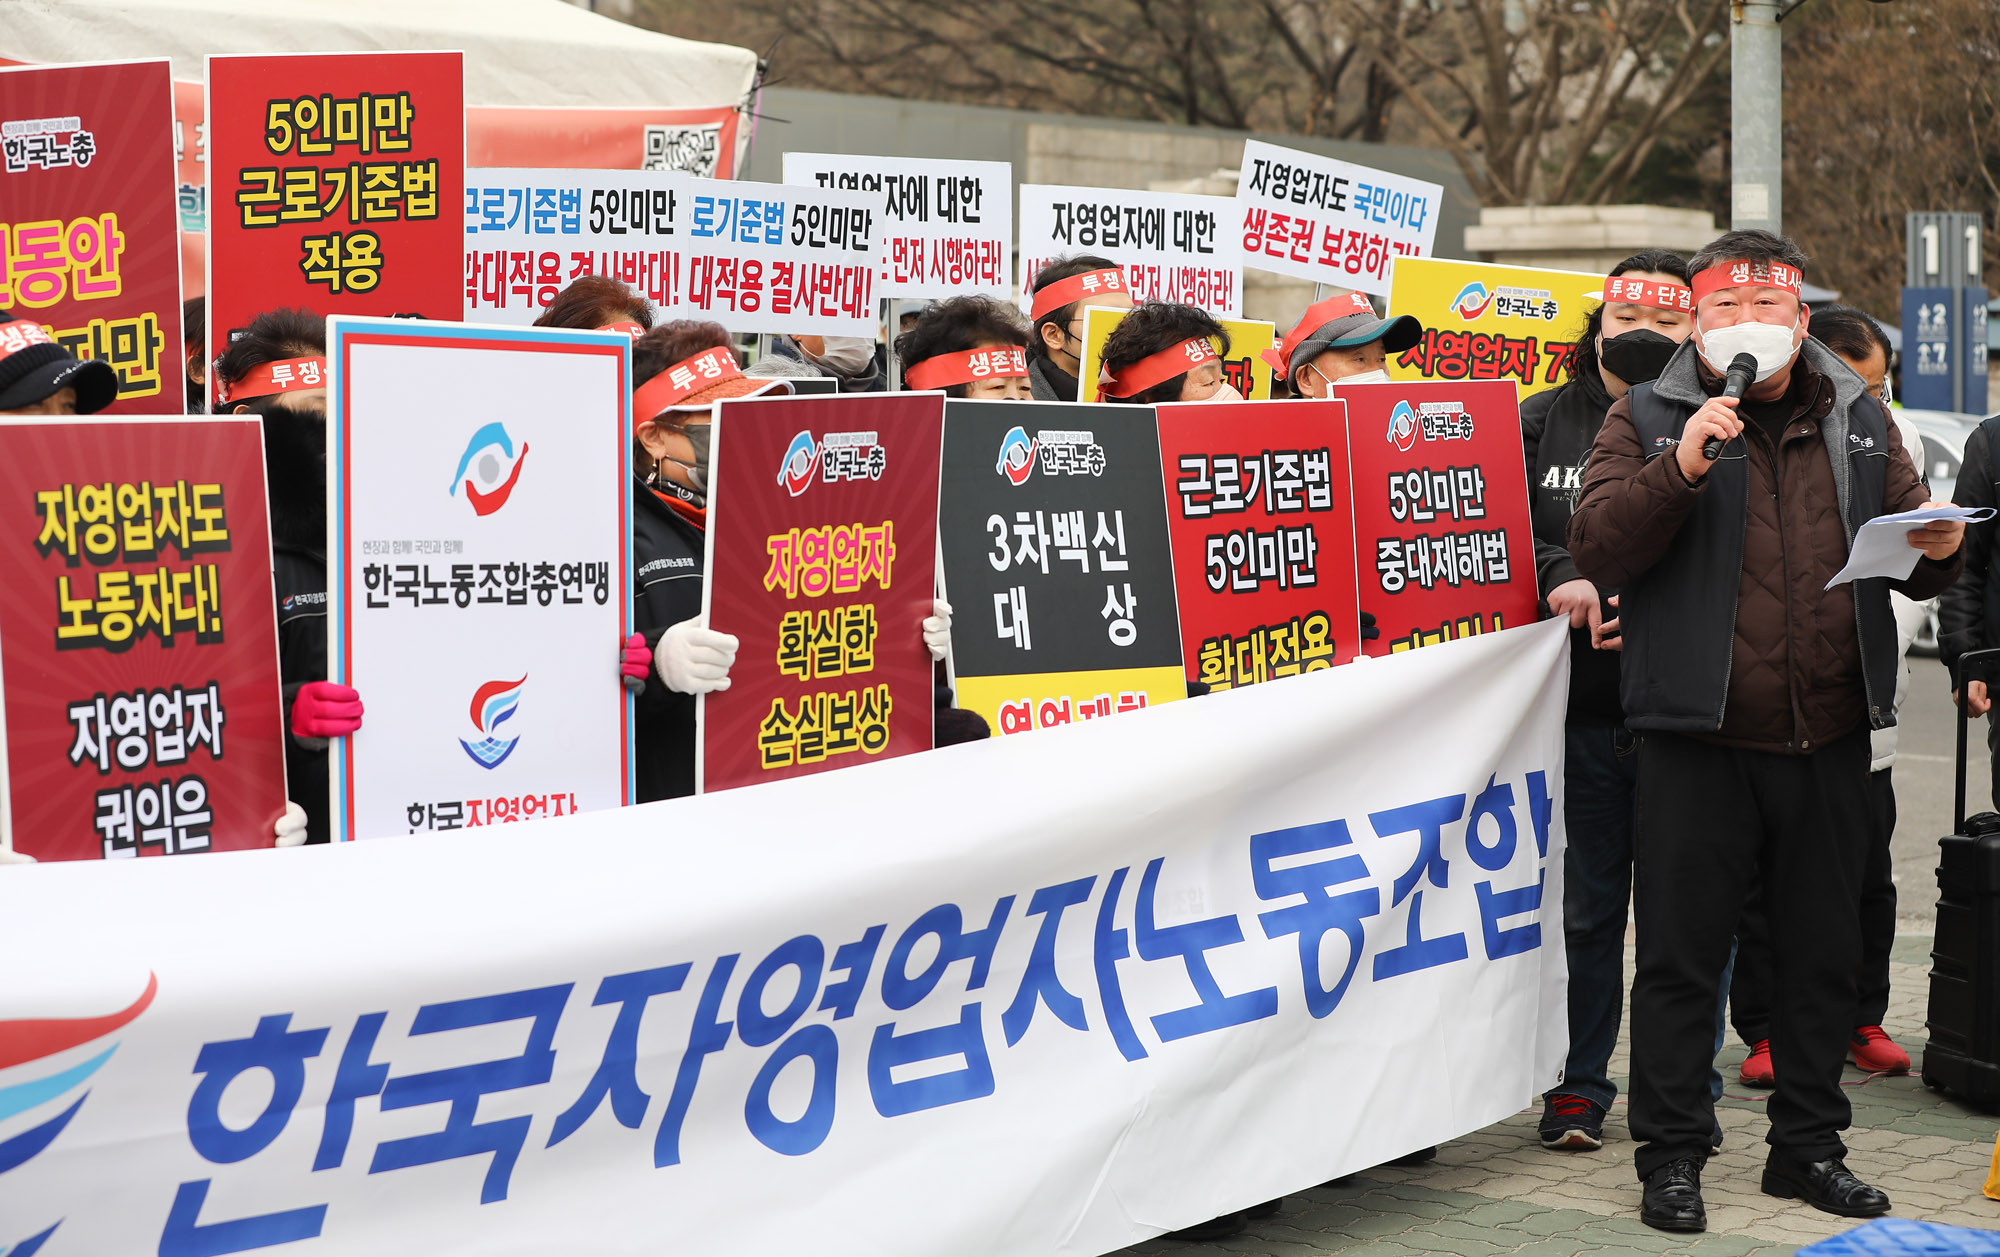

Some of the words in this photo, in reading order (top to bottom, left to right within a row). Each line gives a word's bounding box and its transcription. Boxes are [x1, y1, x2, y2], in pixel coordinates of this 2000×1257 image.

[5, 133, 94, 170] 한국노총
[267, 94, 413, 153] 5인미만
[237, 161, 439, 226] 근로기준법
[589, 188, 677, 235] 5인미만
[936, 175, 983, 224] 대한
[1249, 157, 1350, 212] 자영업자도
[1353, 182, 1428, 233] 국민이다
[790, 203, 872, 252] 5인미만
[1051, 201, 1166, 252] 자영업자에
[1173, 209, 1216, 254] 대한
[1243, 206, 1316, 263] 생존권
[1317, 224, 1420, 281] 보장하
[1920, 224, 1940, 276] 1
[1964, 224, 1980, 276] 1
[301, 232, 382, 292] 적용
[689, 254, 763, 313] 대적용
[769, 260, 872, 319] 결사반대!
[892, 236, 925, 285] 먼저
[929, 236, 1002, 286] 시행하라!
[1165, 265, 1234, 312] 시행하라!
[1496, 296, 1558, 321] 한국노총
[1400, 329, 1539, 383] 자영업자
[1421, 413, 1474, 440] 한국노총
[823, 447, 885, 480] 한국노총
[1040, 445, 1104, 475] 한국노총
[1177, 449, 1332, 517] 근로기준법
[36, 480, 229, 558] 자영업자도
[1389, 466, 1486, 522] 5인미만
[765, 521, 895, 599] 자영업자
[985, 509, 1130, 574] 3차백신
[1205, 526, 1318, 591] 5인미만
[1376, 531, 1510, 593] 중대제해법
[56, 564, 221, 642] 노동자다!
[363, 561, 610, 609] 한국노동조합총연맹
[778, 602, 878, 682] 확실한
[994, 585, 1032, 651] 대
[1101, 582, 1139, 648] 상
[1199, 614, 1335, 692] 확대적용
[69, 685, 224, 772] 자영업자
[759, 683, 892, 771] 손실보상
[999, 694, 1147, 736] 영업
[95, 779, 212, 859] 권익은
[158, 770, 1554, 1257] 한국자영업자노동조합
